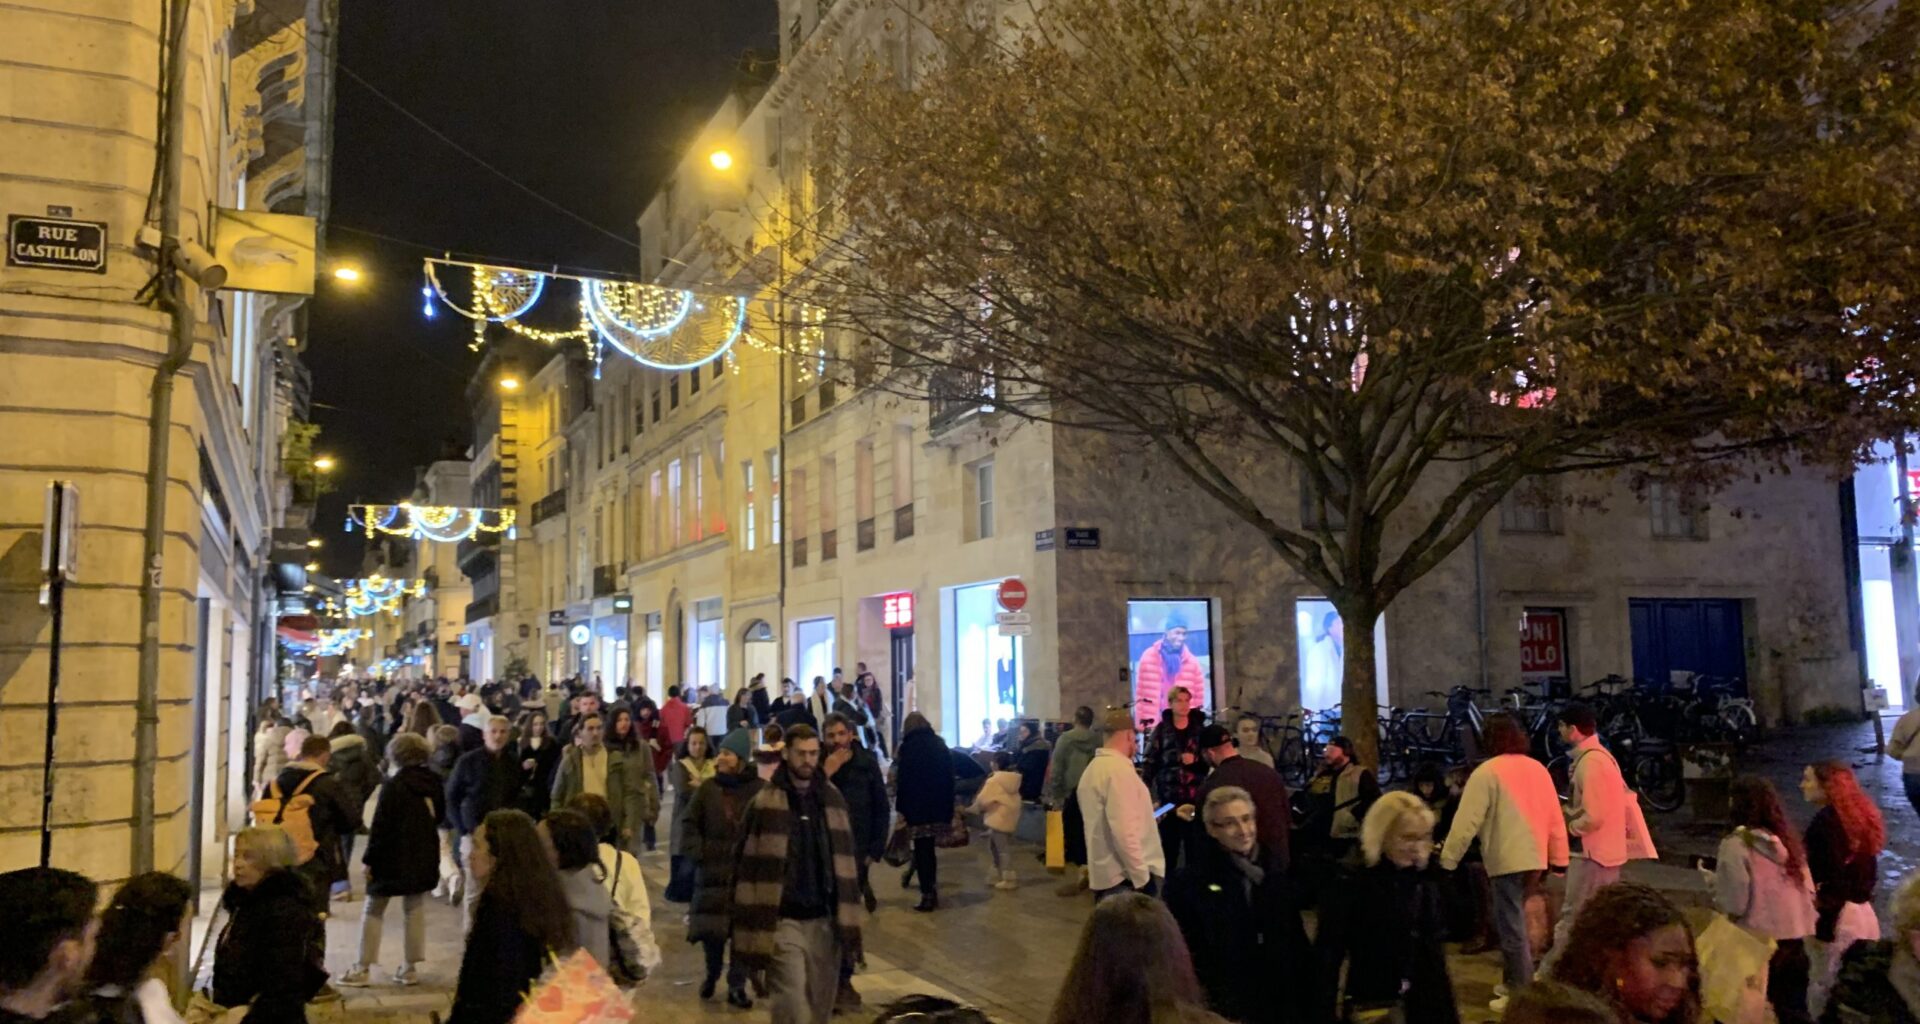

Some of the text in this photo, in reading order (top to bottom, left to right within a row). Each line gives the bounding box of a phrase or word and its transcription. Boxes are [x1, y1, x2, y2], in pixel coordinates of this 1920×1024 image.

[38, 226, 78, 241] RUE
[16, 243, 98, 262] CASTILLON
[1519, 622, 1552, 642] UNI
[1521, 645, 1556, 668] QLO
